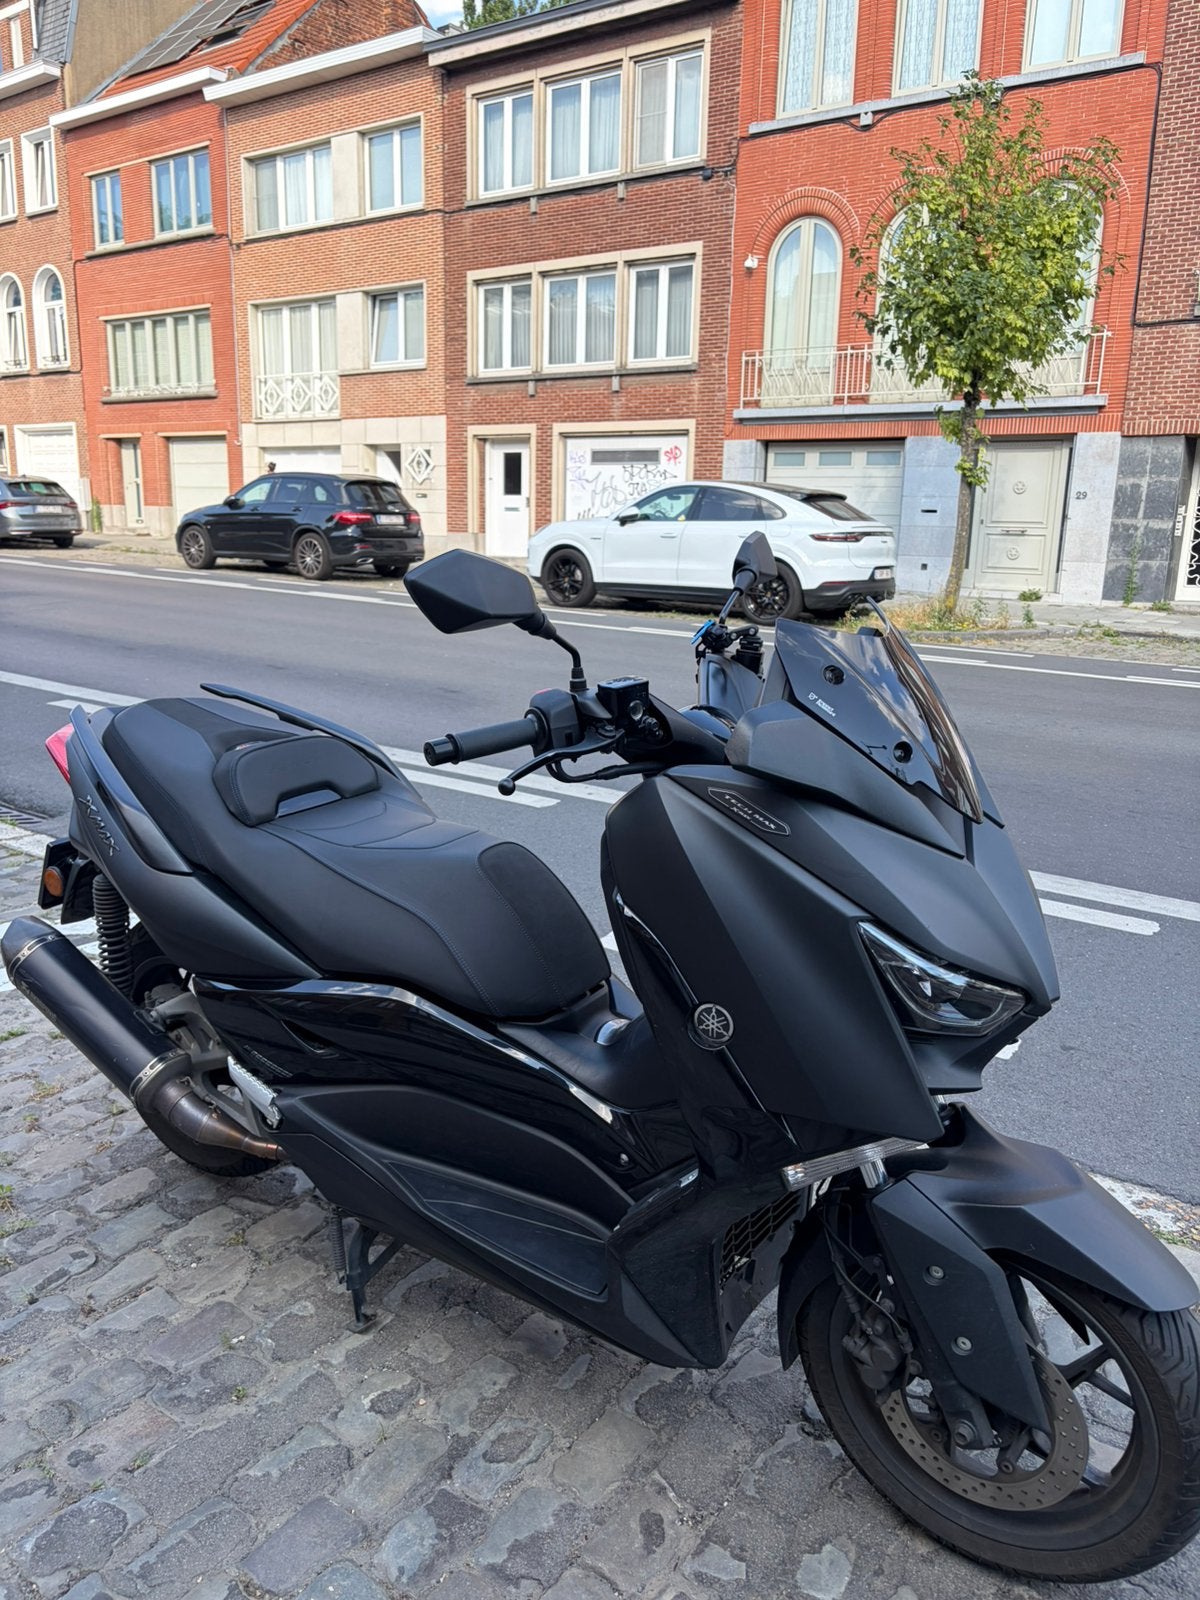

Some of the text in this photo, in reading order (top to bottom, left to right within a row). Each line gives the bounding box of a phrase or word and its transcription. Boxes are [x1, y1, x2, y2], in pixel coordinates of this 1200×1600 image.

[1075, 491, 1088, 500] 29
[723, 794, 777, 830] TECH MAX
